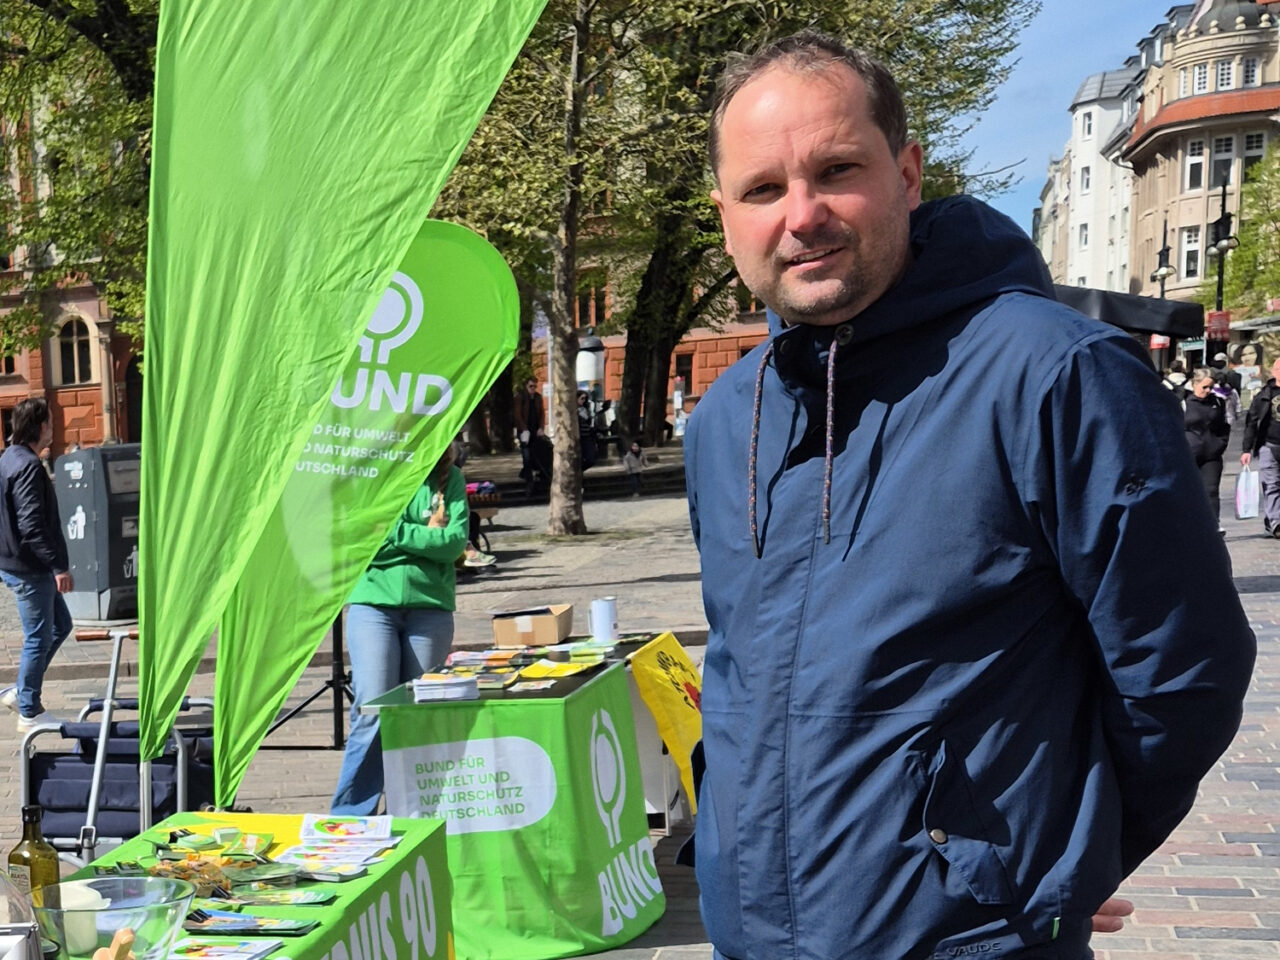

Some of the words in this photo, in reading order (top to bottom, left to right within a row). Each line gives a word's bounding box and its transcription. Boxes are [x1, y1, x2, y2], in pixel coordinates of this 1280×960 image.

[331, 367, 454, 417] UND
[325, 423, 351, 438] FÜR
[353, 428, 412, 444] UMWELT
[314, 442, 416, 464] NATURSCHUTZ
[295, 460, 380, 479] UTSCHLAND
[415, 760, 456, 775] BUND
[459, 754, 486, 769] FÜR
[417, 774, 476, 791] UMWELT
[478, 771, 511, 785] UND
[420, 786, 524, 806] NATURSCHUTZ
[598, 836, 663, 937] BUND
